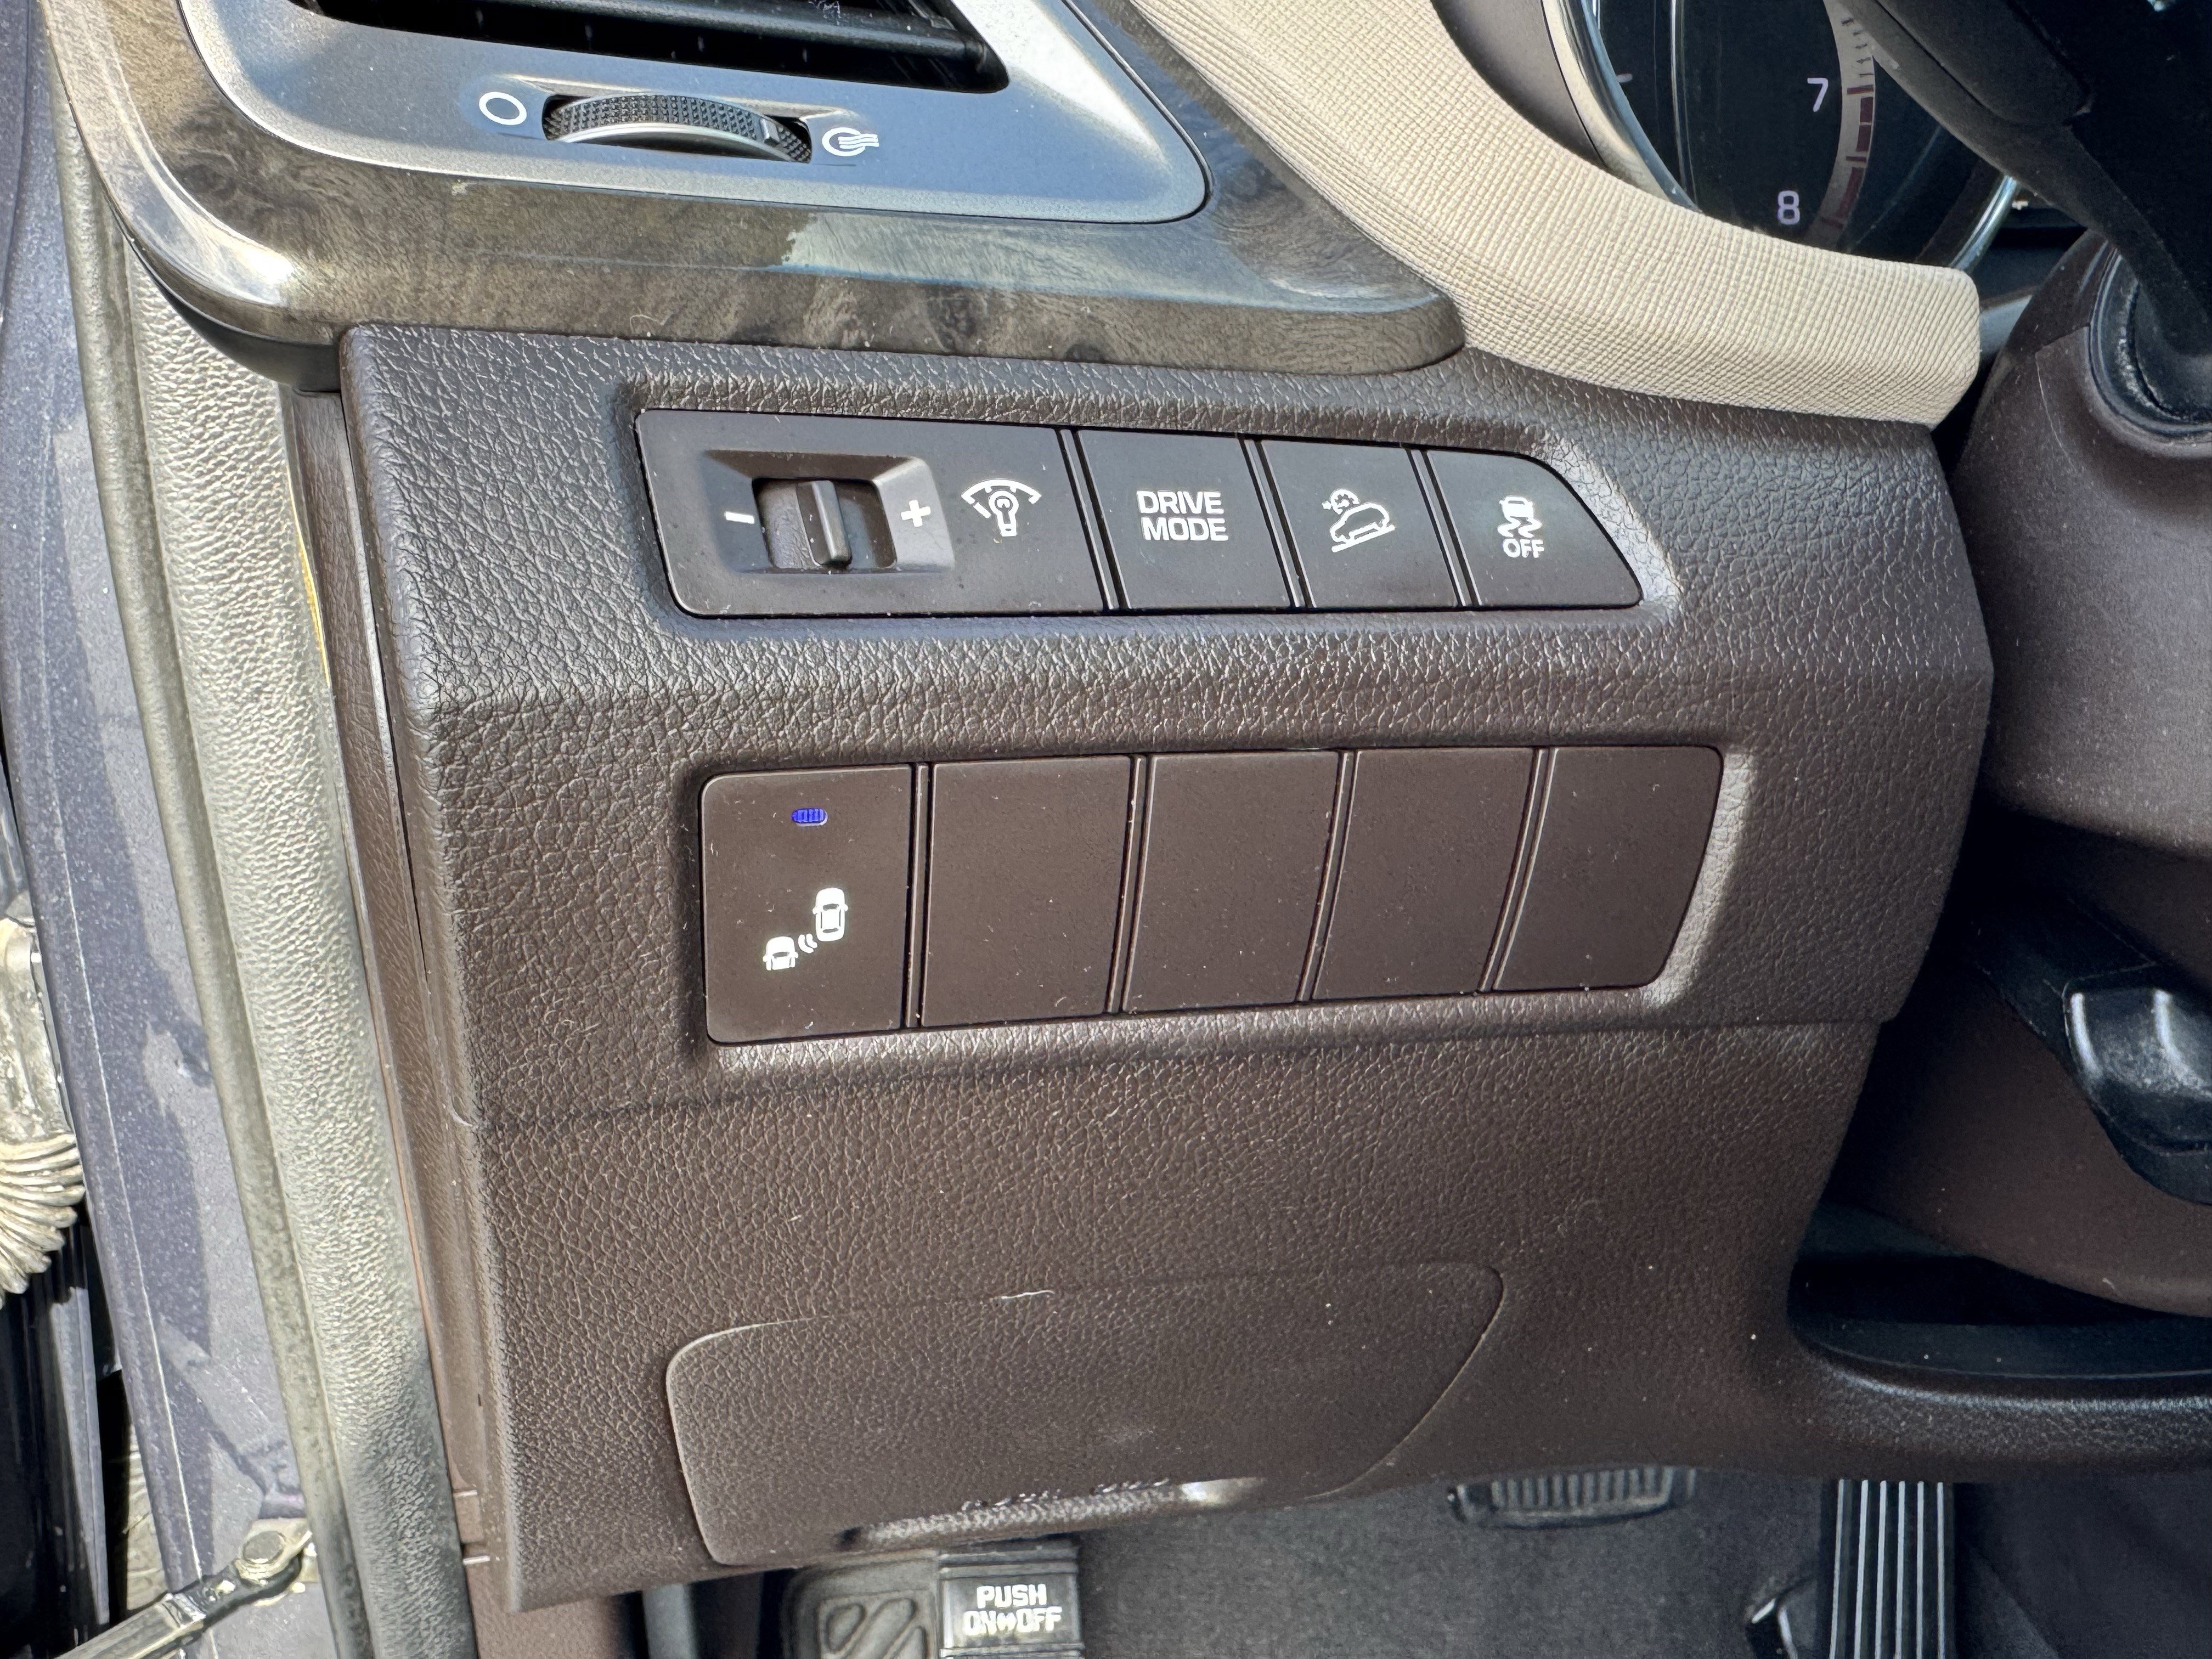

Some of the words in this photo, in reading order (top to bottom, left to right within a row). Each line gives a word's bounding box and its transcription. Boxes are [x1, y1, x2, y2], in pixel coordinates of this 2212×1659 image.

[1807, 78, 1829, 112] 7
[1778, 190, 1800, 225] 8
[1136, 490, 1224, 514] DRIVE
[1141, 517, 1229, 541] MODE
[1503, 538, 1545, 558] OFF
[977, 1583, 1047, 1609] PUSH
